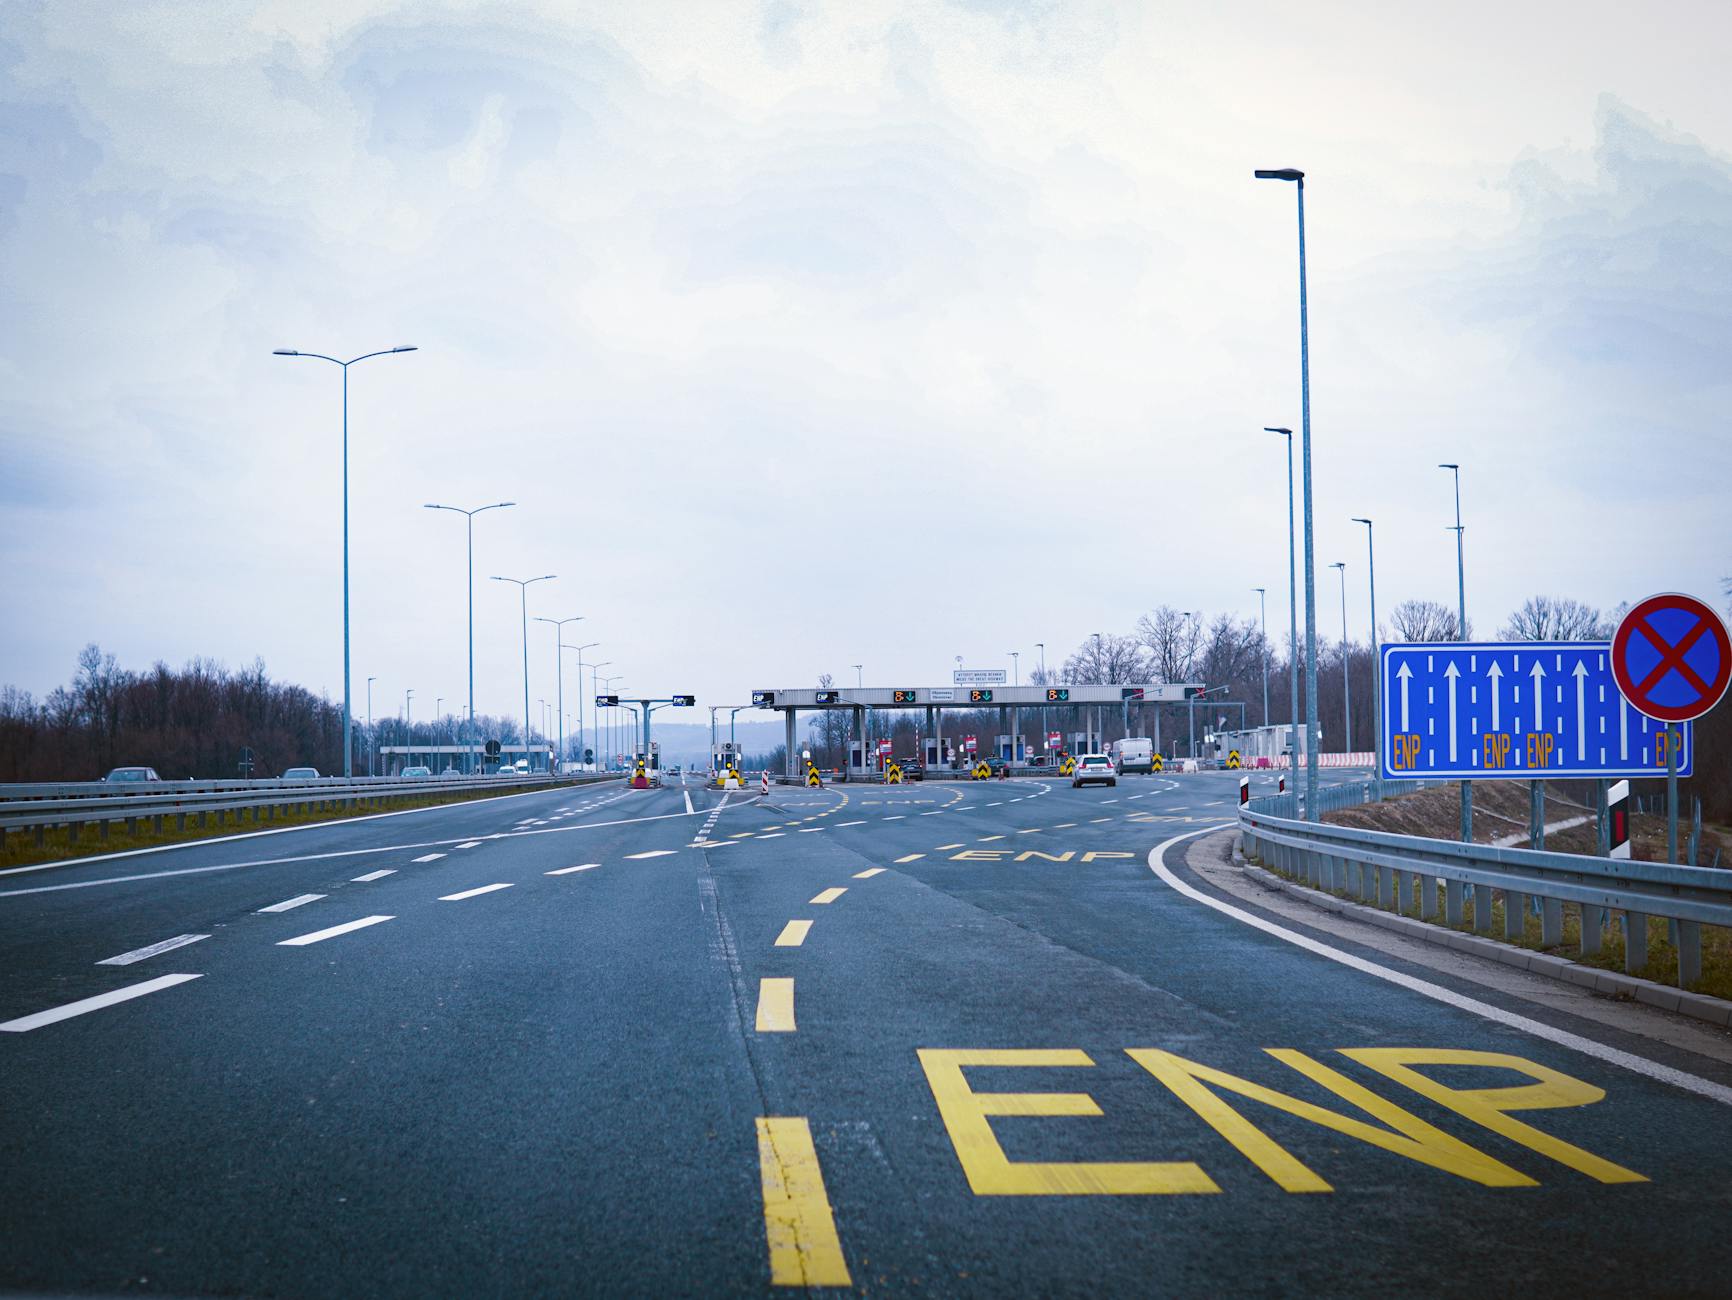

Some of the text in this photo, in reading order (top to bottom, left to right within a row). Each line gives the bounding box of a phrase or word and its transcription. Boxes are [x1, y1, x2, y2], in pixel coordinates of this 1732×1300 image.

[1393, 734, 1421, 769] ENP
[1483, 733, 1511, 768] ENP
[1527, 733, 1553, 768] ENP
[949, 851, 1135, 862] ENP
[916, 1048, 1650, 1195] ENP
